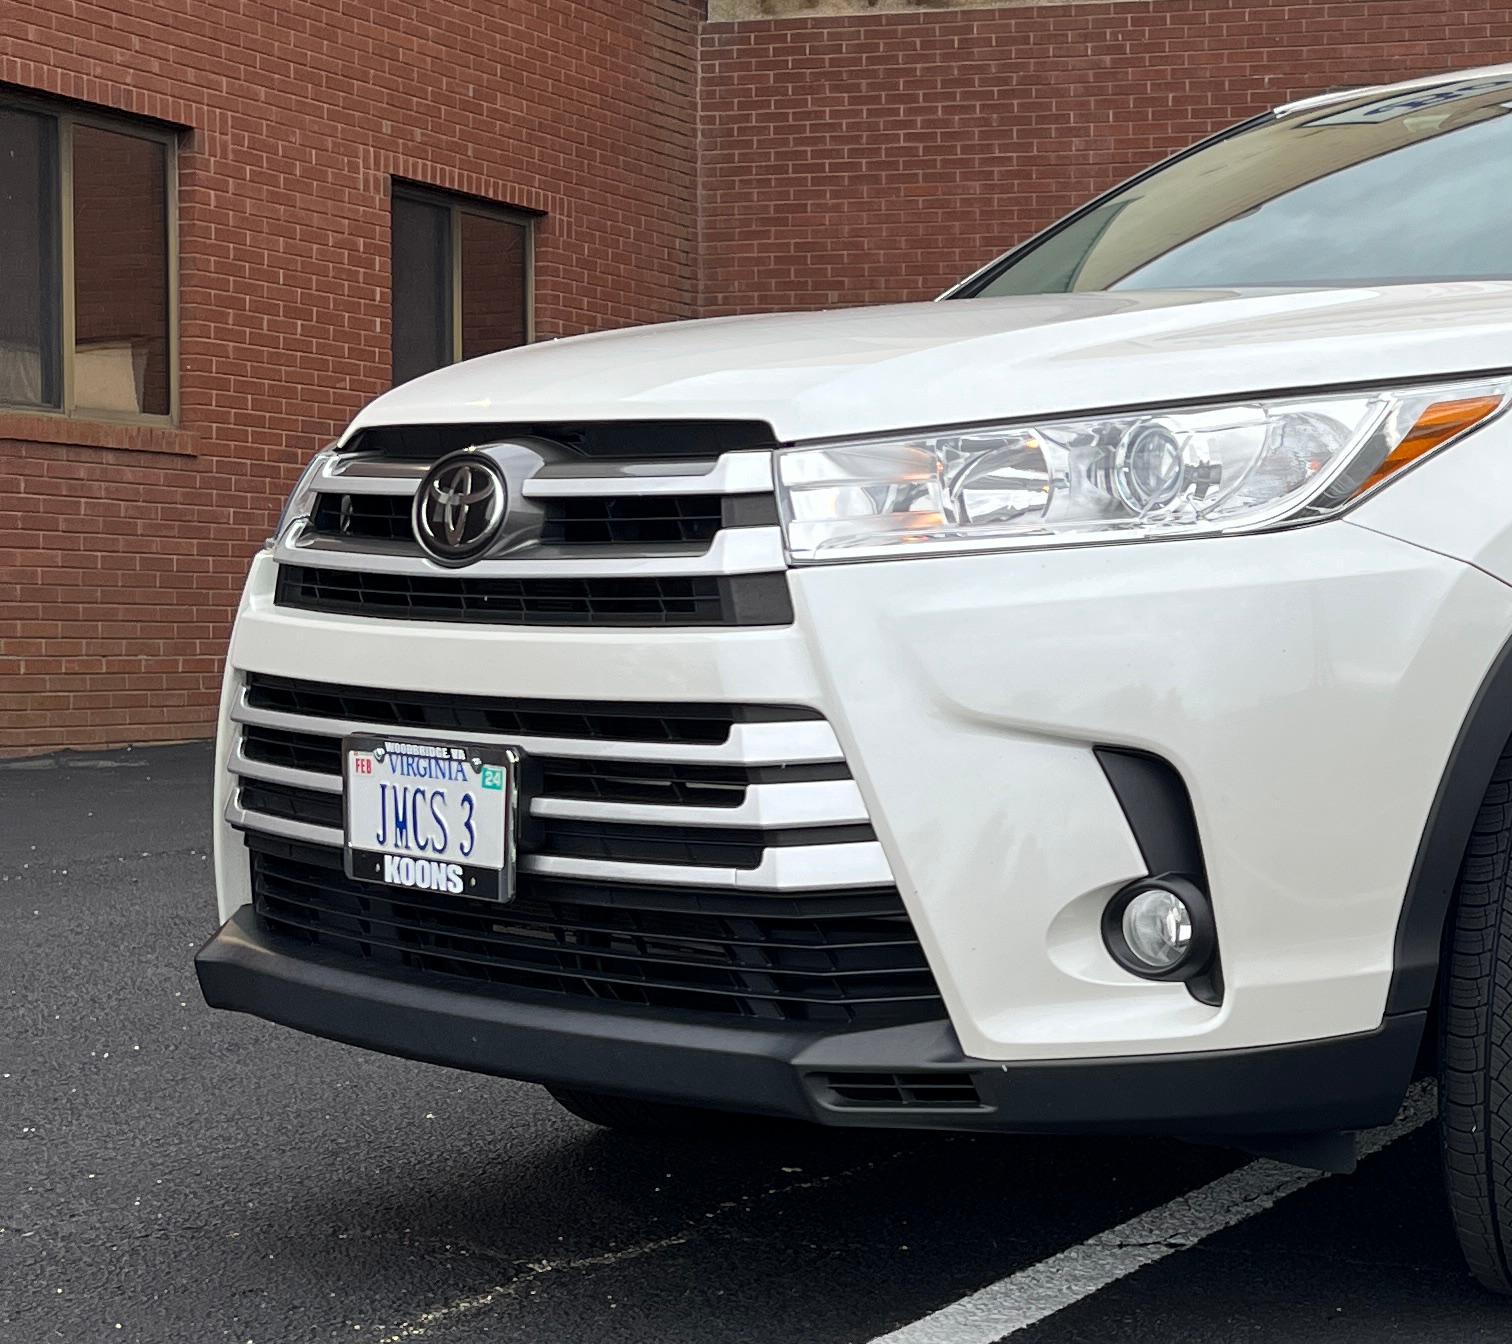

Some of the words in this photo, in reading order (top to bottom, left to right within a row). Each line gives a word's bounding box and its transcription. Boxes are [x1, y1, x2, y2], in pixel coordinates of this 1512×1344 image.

[355, 757, 372, 774] FEB
[388, 754, 468, 782] VIRGINIA
[485, 770, 501, 786] 24
[376, 783, 448, 854] JMCS
[459, 793, 476, 857] 3
[383, 855, 464, 894] KOONS
